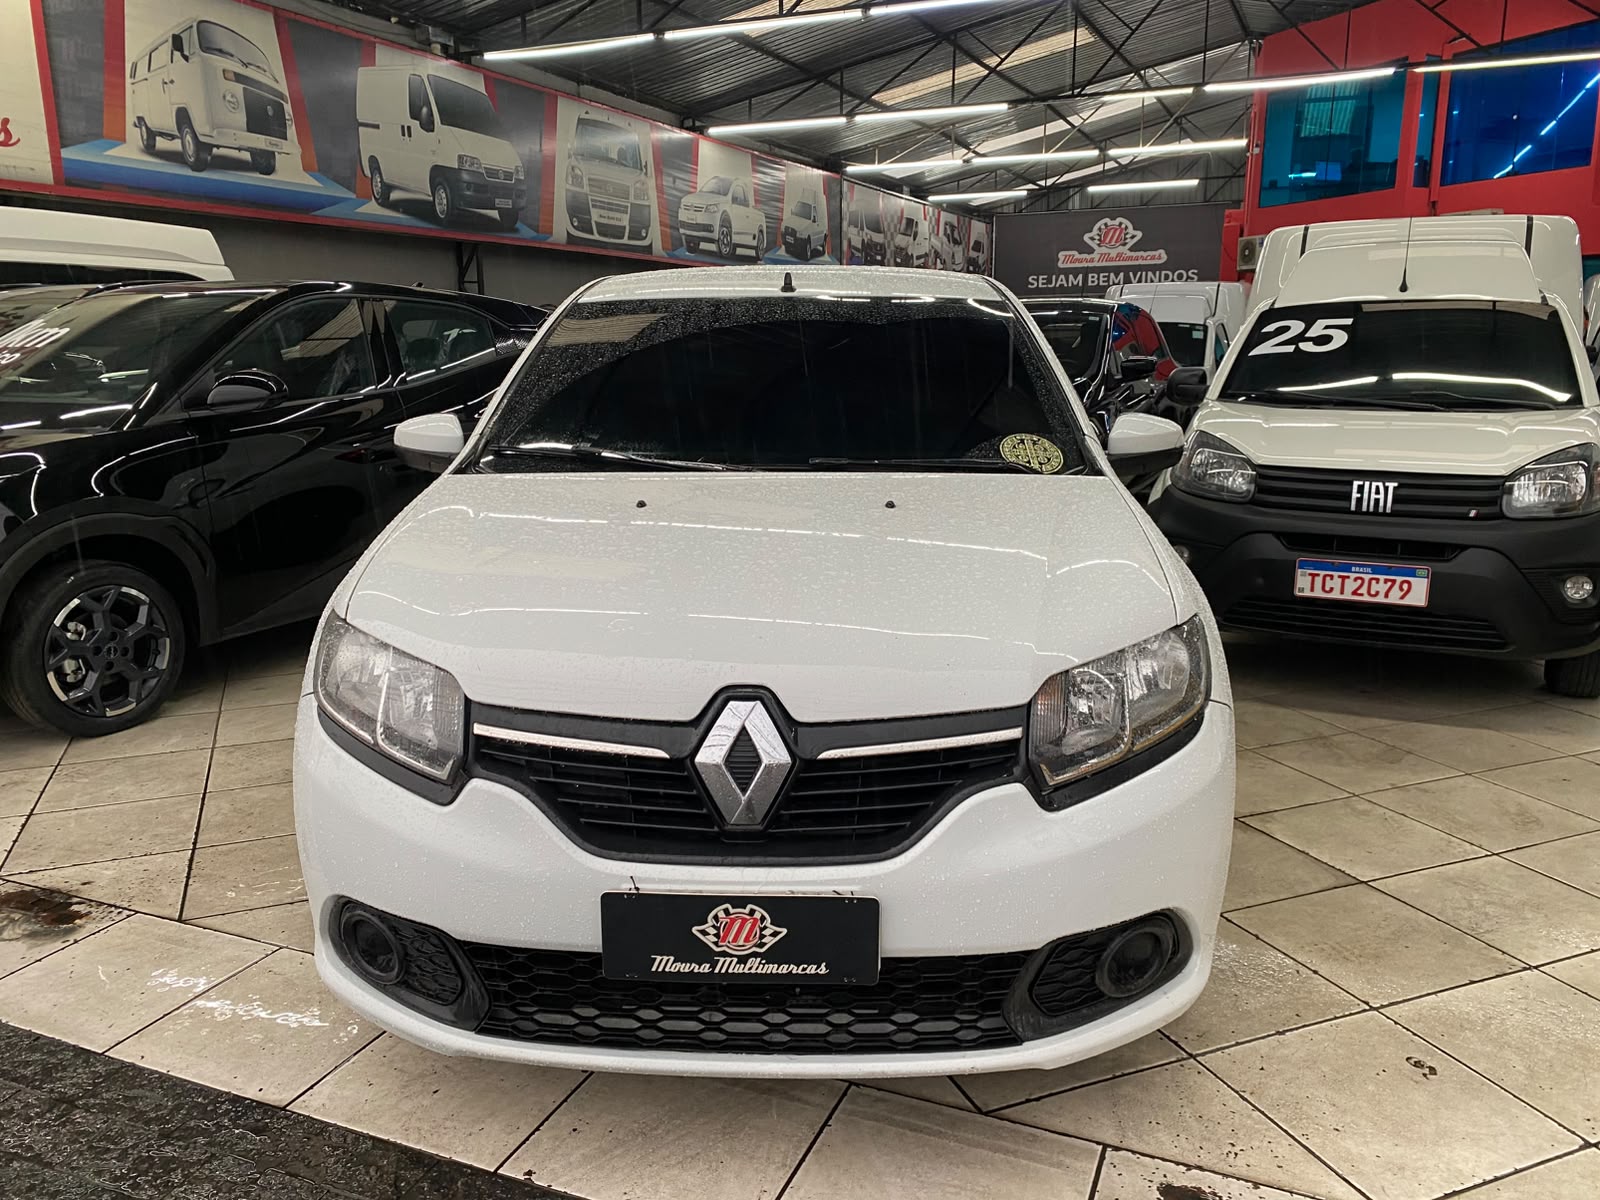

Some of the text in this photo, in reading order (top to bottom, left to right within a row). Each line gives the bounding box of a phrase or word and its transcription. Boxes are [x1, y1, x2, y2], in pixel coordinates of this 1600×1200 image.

[1061, 251, 1163, 265] Moura Multimarcas
[1028, 269, 1199, 288] SEJAM BEM VINDOS
[1247, 318, 1354, 356] 25
[1350, 480, 1399, 513] FIAT
[1351, 566, 1373, 574] BRASIL
[1307, 572, 1413, 600] TCT2C79
[650, 955, 830, 975] Moura Multimarcas
